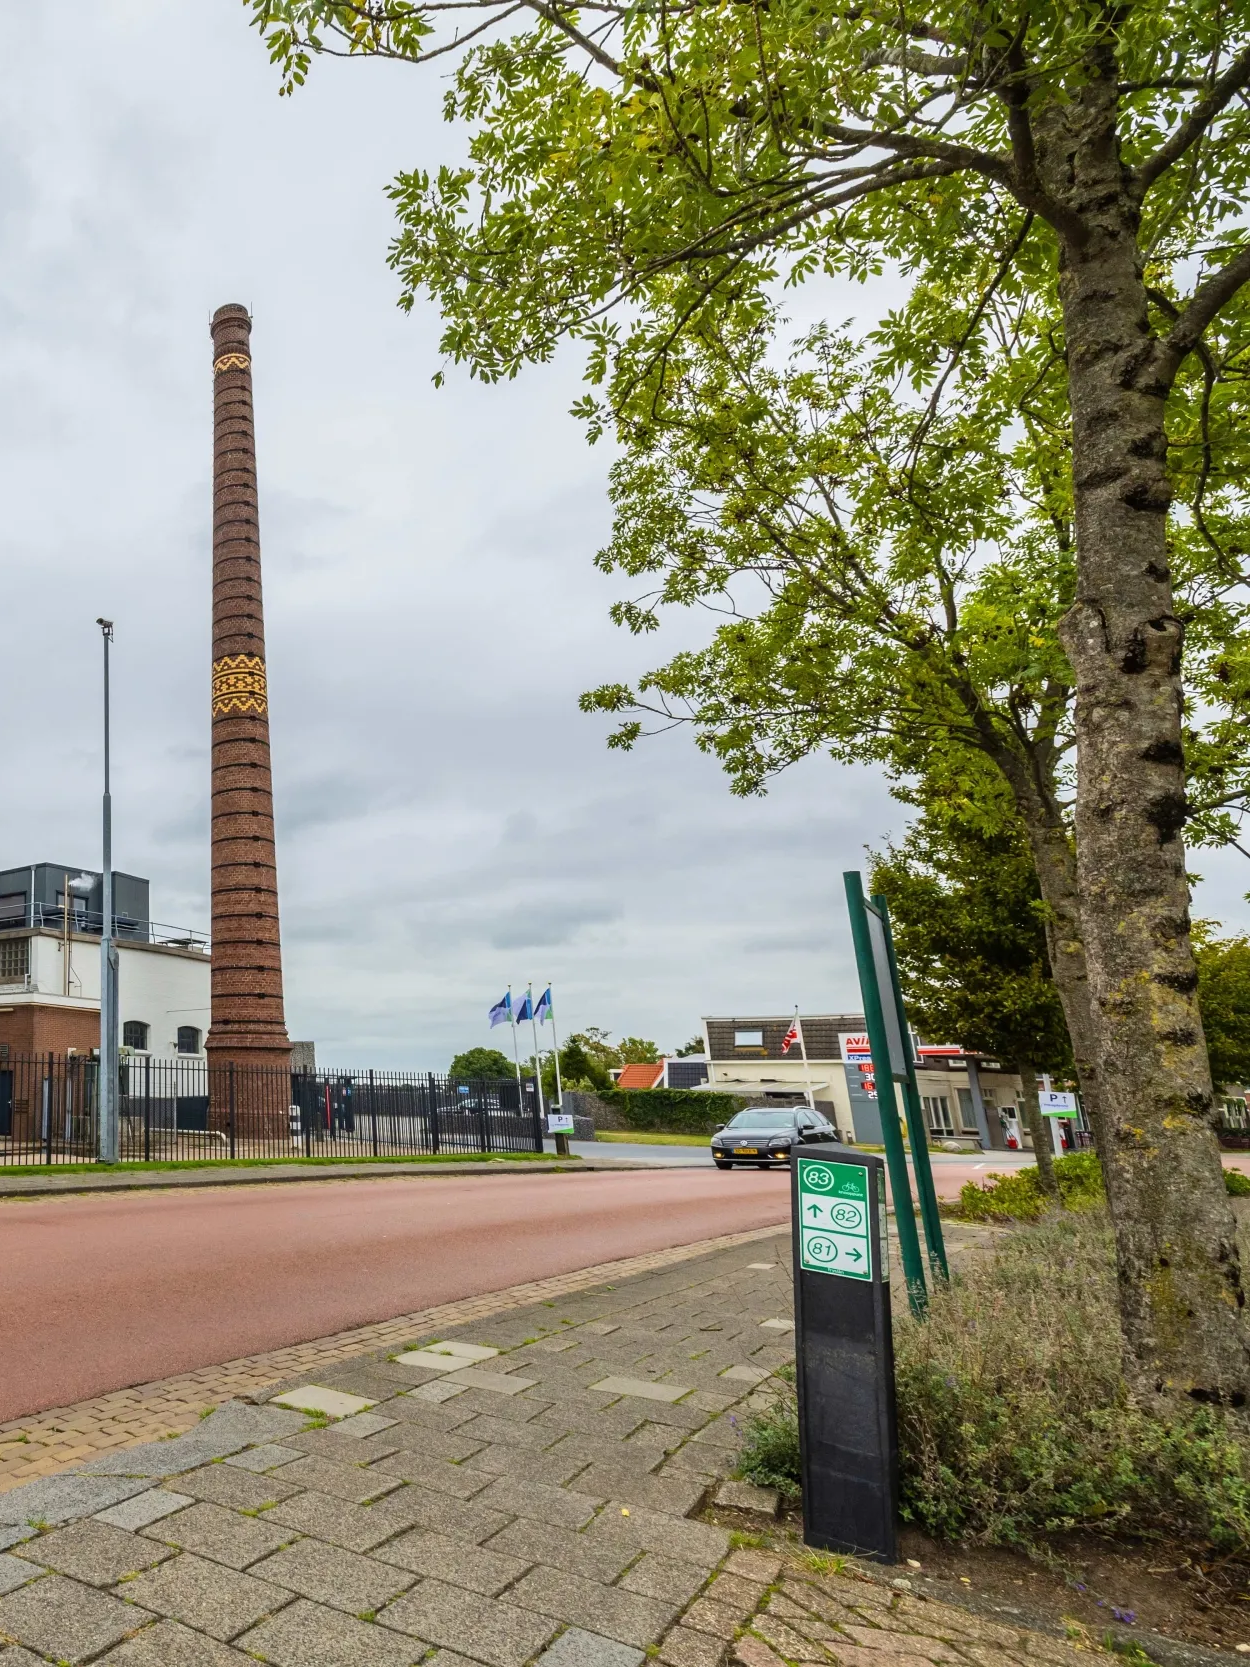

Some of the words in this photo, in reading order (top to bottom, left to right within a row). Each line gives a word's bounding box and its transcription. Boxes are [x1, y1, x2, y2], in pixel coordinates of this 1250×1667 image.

[1049, 1093, 1058, 1102] P
[808, 1171, 829, 1185] 83
[835, 1208, 857, 1223] 82
[812, 1242, 832, 1256] 81
